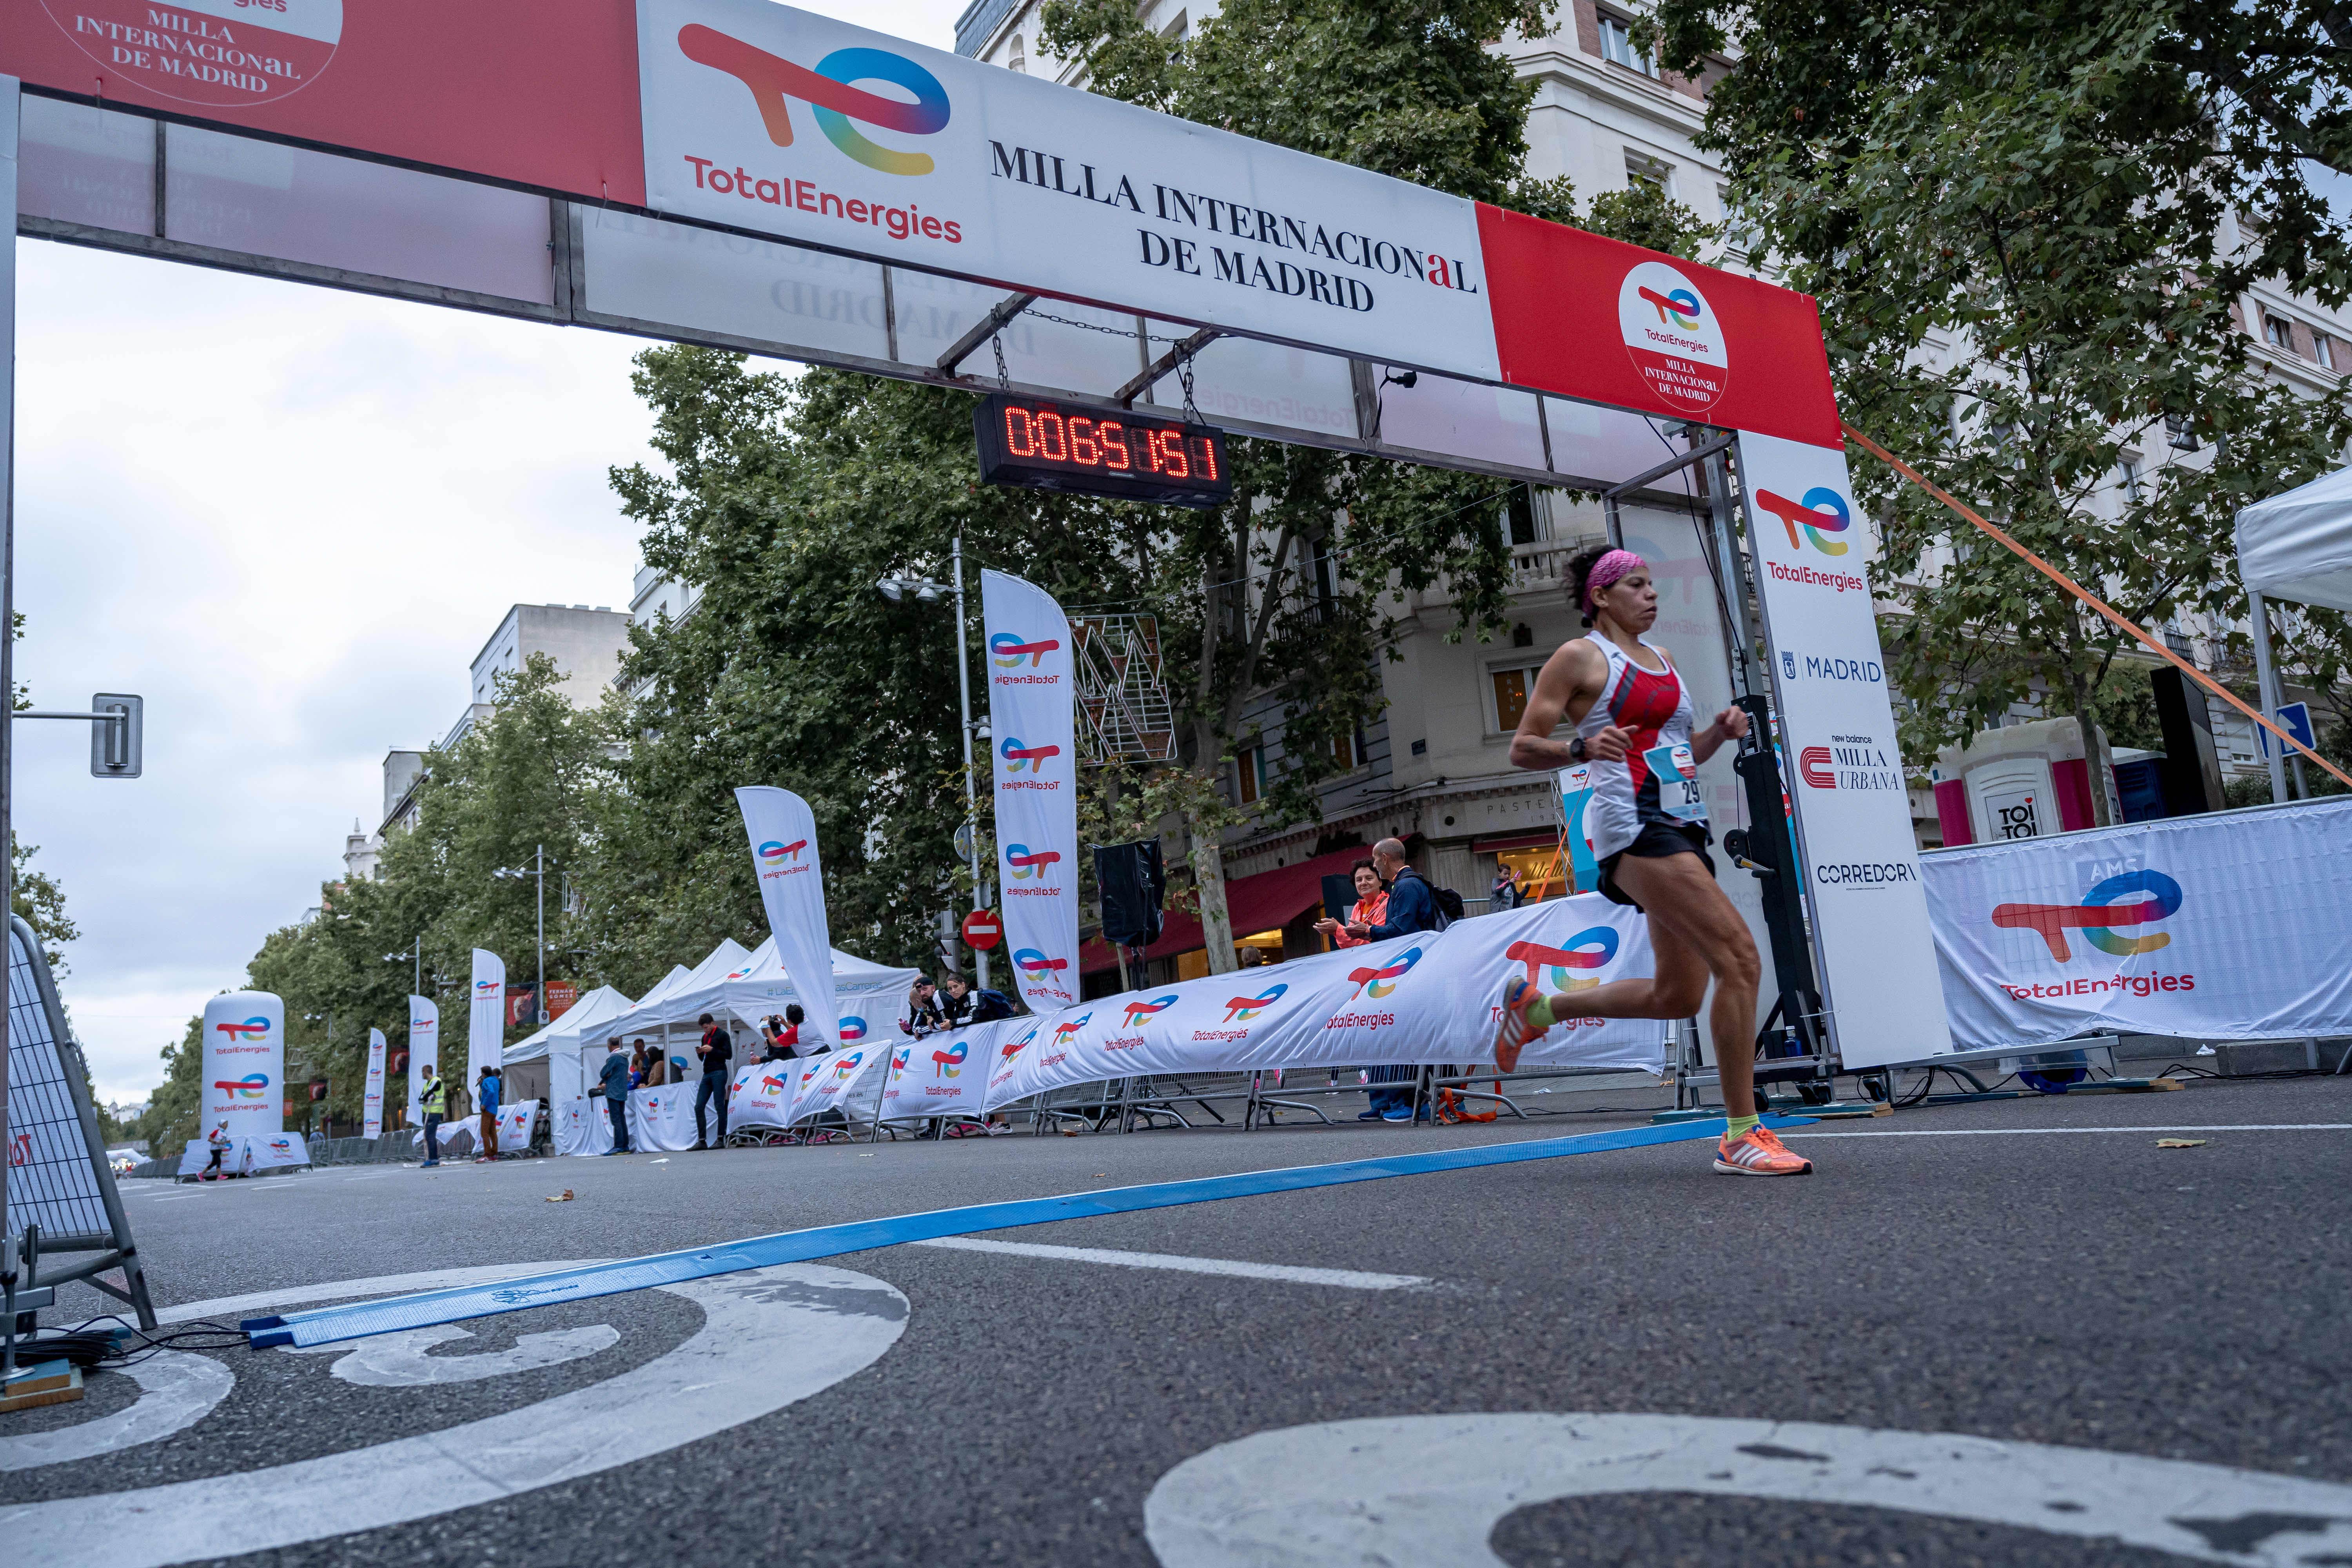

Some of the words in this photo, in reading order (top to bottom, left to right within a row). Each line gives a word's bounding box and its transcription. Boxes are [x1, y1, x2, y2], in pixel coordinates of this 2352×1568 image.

[147, 9, 235, 44] MILLA
[113, 46, 151, 69] DE
[159, 58, 268, 93] MADRID
[988, 140, 1145, 214] MILLA
[684, 155, 962, 243] TotalEnergies
[1137, 229, 1201, 276] DE
[1210, 246, 1374, 312] MADRID
[1645, 328, 1708, 353] TotalEnergies
[1665, 358, 1696, 374] MILLA
[1659, 383, 1672, 394] DE
[1674, 386, 1710, 403] MADRID
[1767, 561, 1863, 593] TotalEnergies
[1806, 656, 1881, 682] MADRID
[1832, 734, 1844, 743] new
[1846, 734, 1872, 744] balance
[1835, 748, 1888, 767] MILLA
[1840, 771, 1900, 790] URBANA
[1998, 804, 2035, 825] TOI
[2002, 821, 2038, 840] TOI
[2000, 971, 2195, 1001] TotalEnergies
[1104, 1034, 1144, 1051] TotalEnergies
[1192, 1027, 1249, 1043] TotalEnergies
[215, 1045, 270, 1055] TotalEnergies
[925, 1085, 961, 1098] TotalEnergies
[213, 1103, 269, 1113] TotalEnergies
